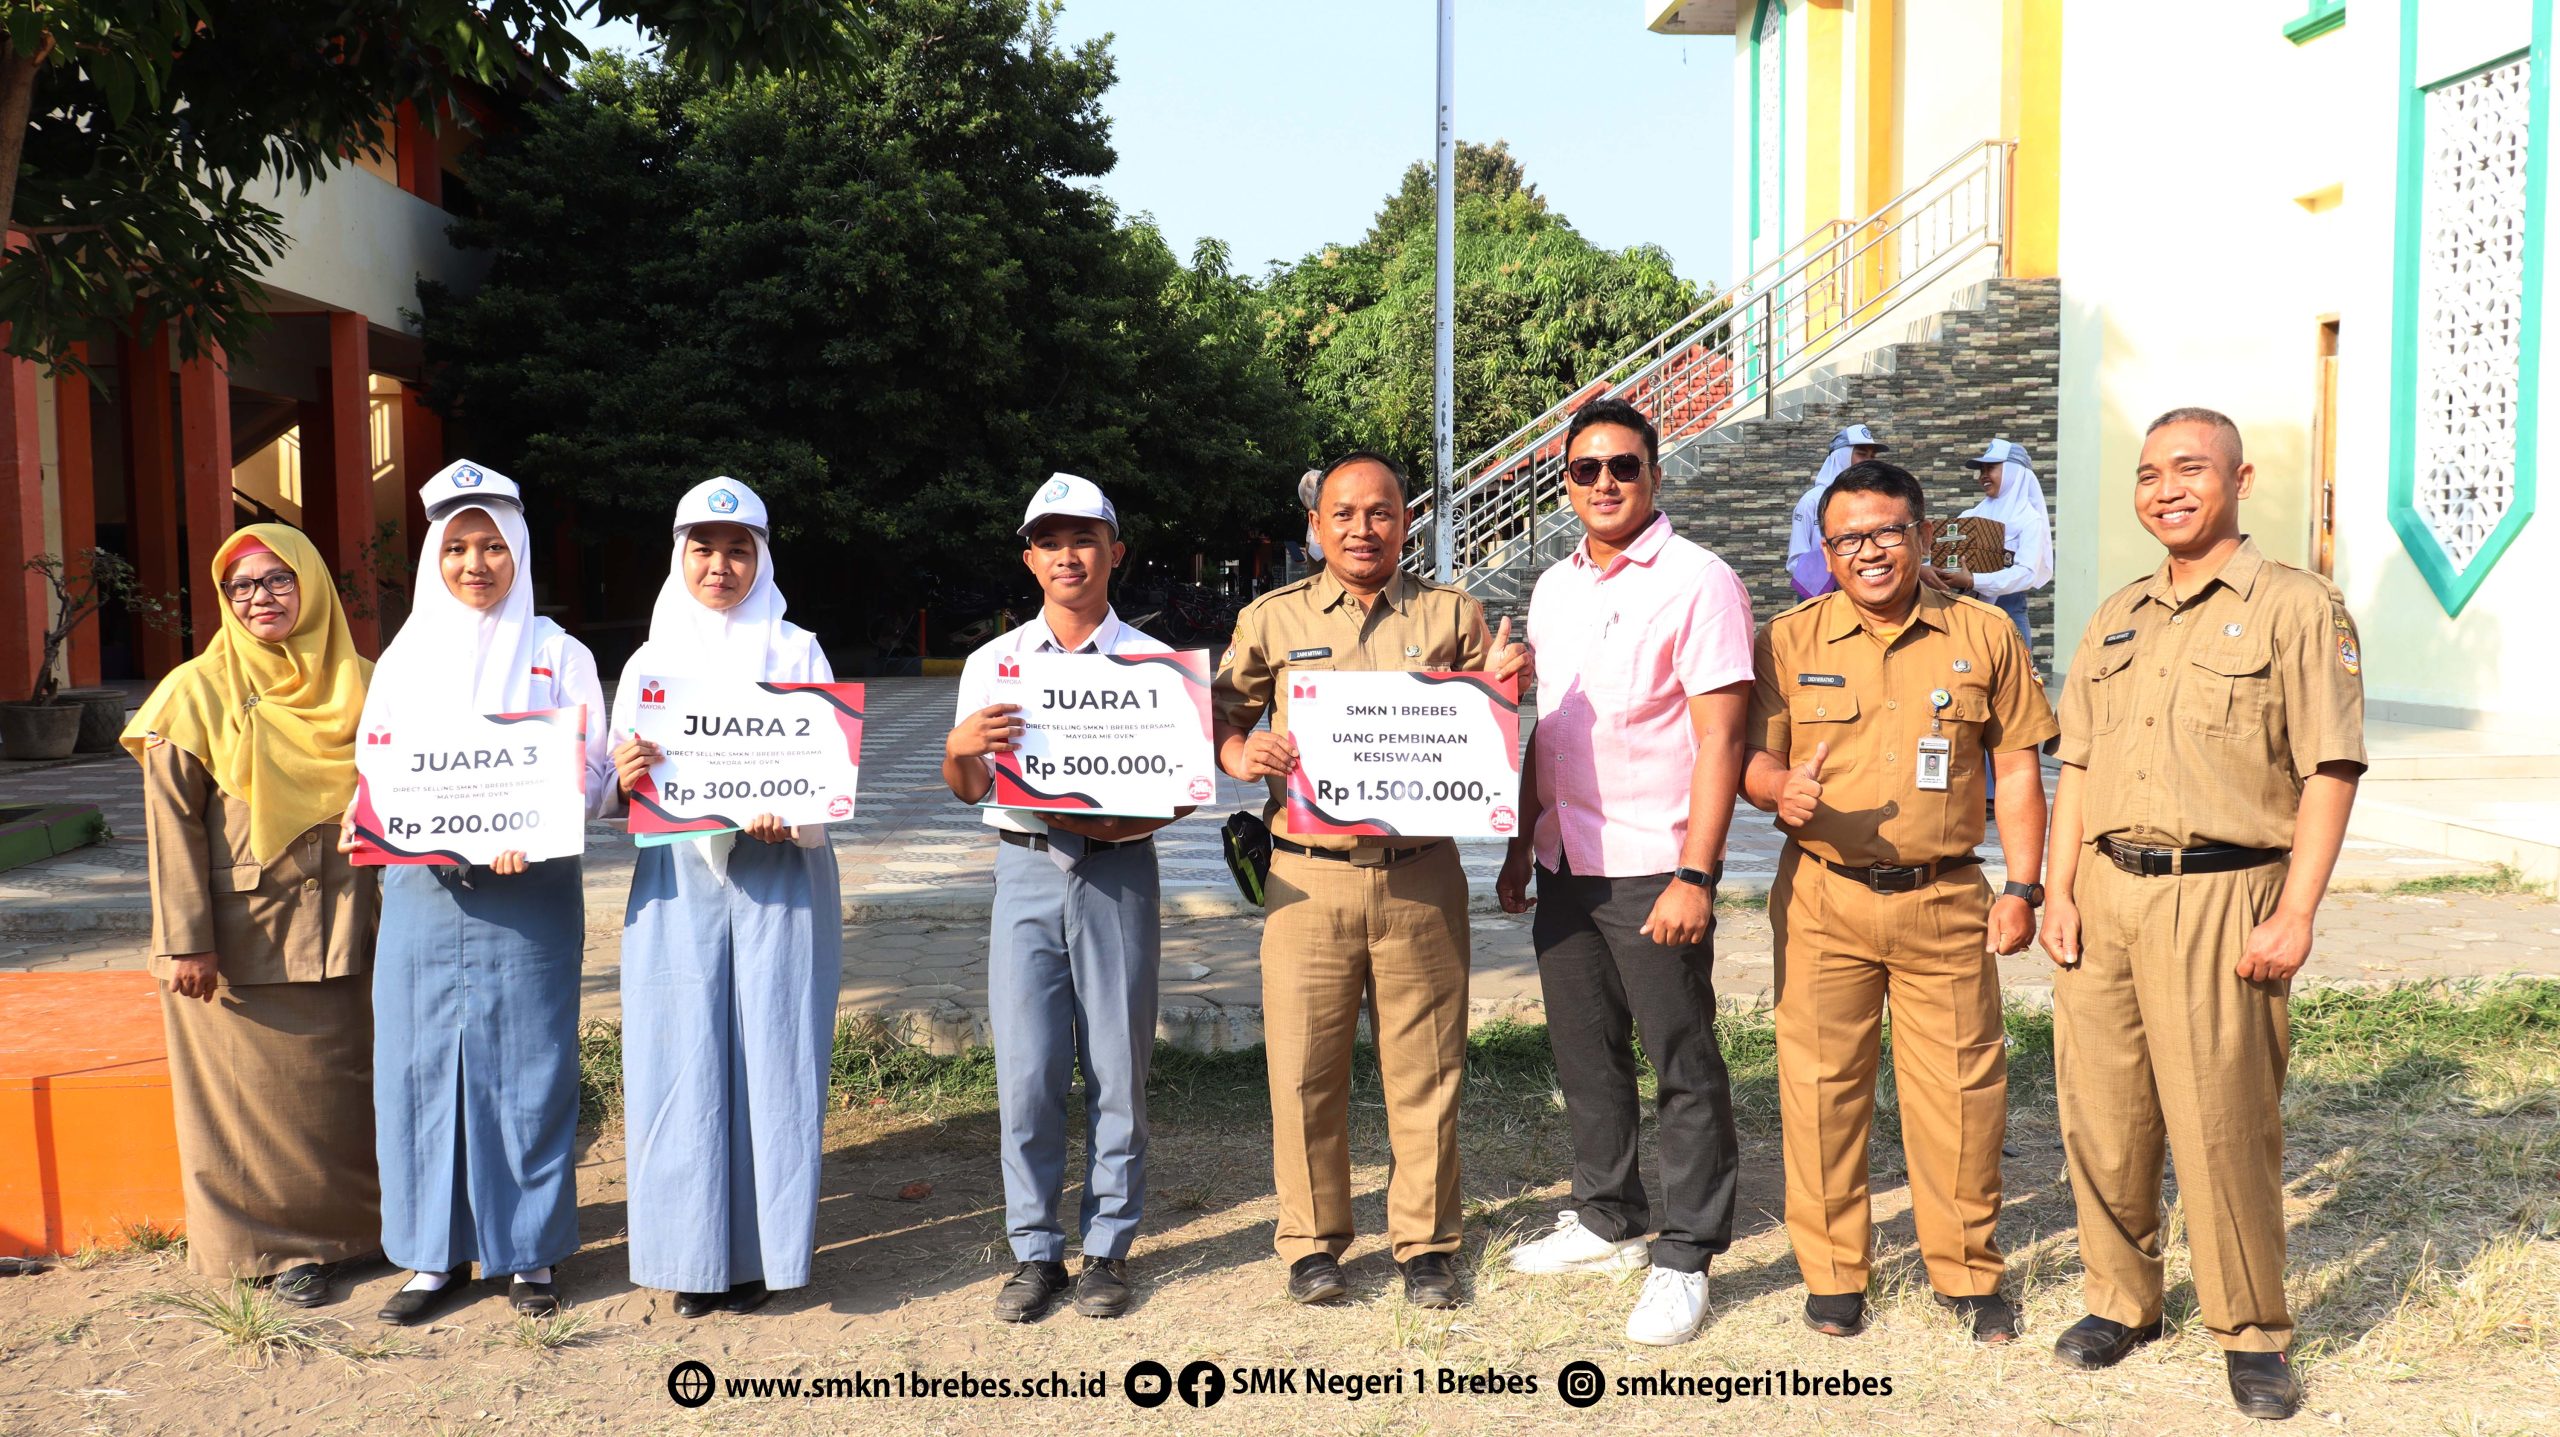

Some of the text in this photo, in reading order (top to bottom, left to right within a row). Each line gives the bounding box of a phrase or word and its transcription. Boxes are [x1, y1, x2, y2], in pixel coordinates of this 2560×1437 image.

[1042, 689, 1157, 710] JUARA 1
[1346, 705, 1457, 716] SMKN 1 BREBES
[683, 715, 810, 737] JUARA 2
[1332, 733, 1468, 744] UANG PEMBINAAN
[411, 745, 538, 773] JUARA 3
[666, 749, 694, 757] DIRECT
[1354, 752, 1442, 763] KESISWAAN
[1025, 754, 1183, 781] Rp 500.000,-
[664, 778, 826, 806] Rp 300.000,-
[1318, 780, 1501, 806] Rp 1.500.000,-
[388, 816, 422, 839] Rp
